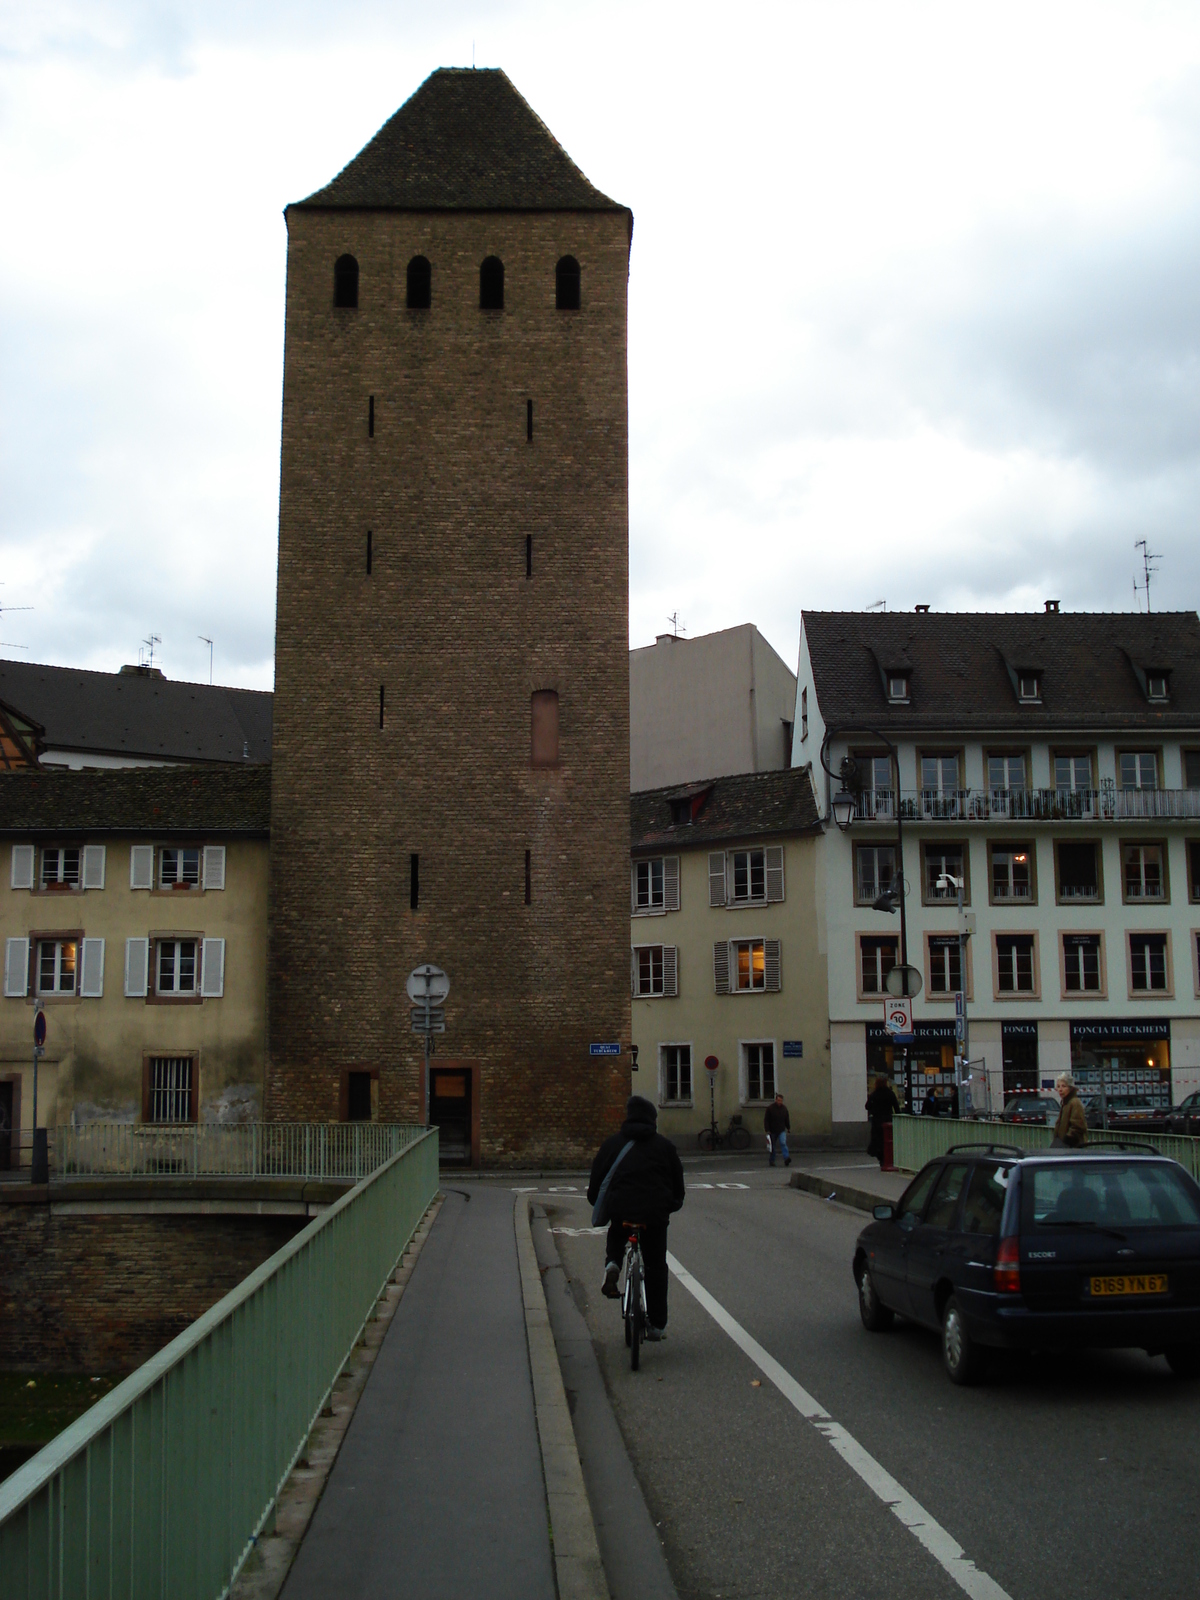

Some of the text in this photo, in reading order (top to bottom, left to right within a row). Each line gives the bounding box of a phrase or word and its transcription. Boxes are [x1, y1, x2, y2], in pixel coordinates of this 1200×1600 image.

[913, 1029, 957, 1037] URCKHEI
[1073, 1025, 1167, 1034] FONCIA TURCKHEIM
[1093, 1276, 1165, 1292] 8169 YN 67
